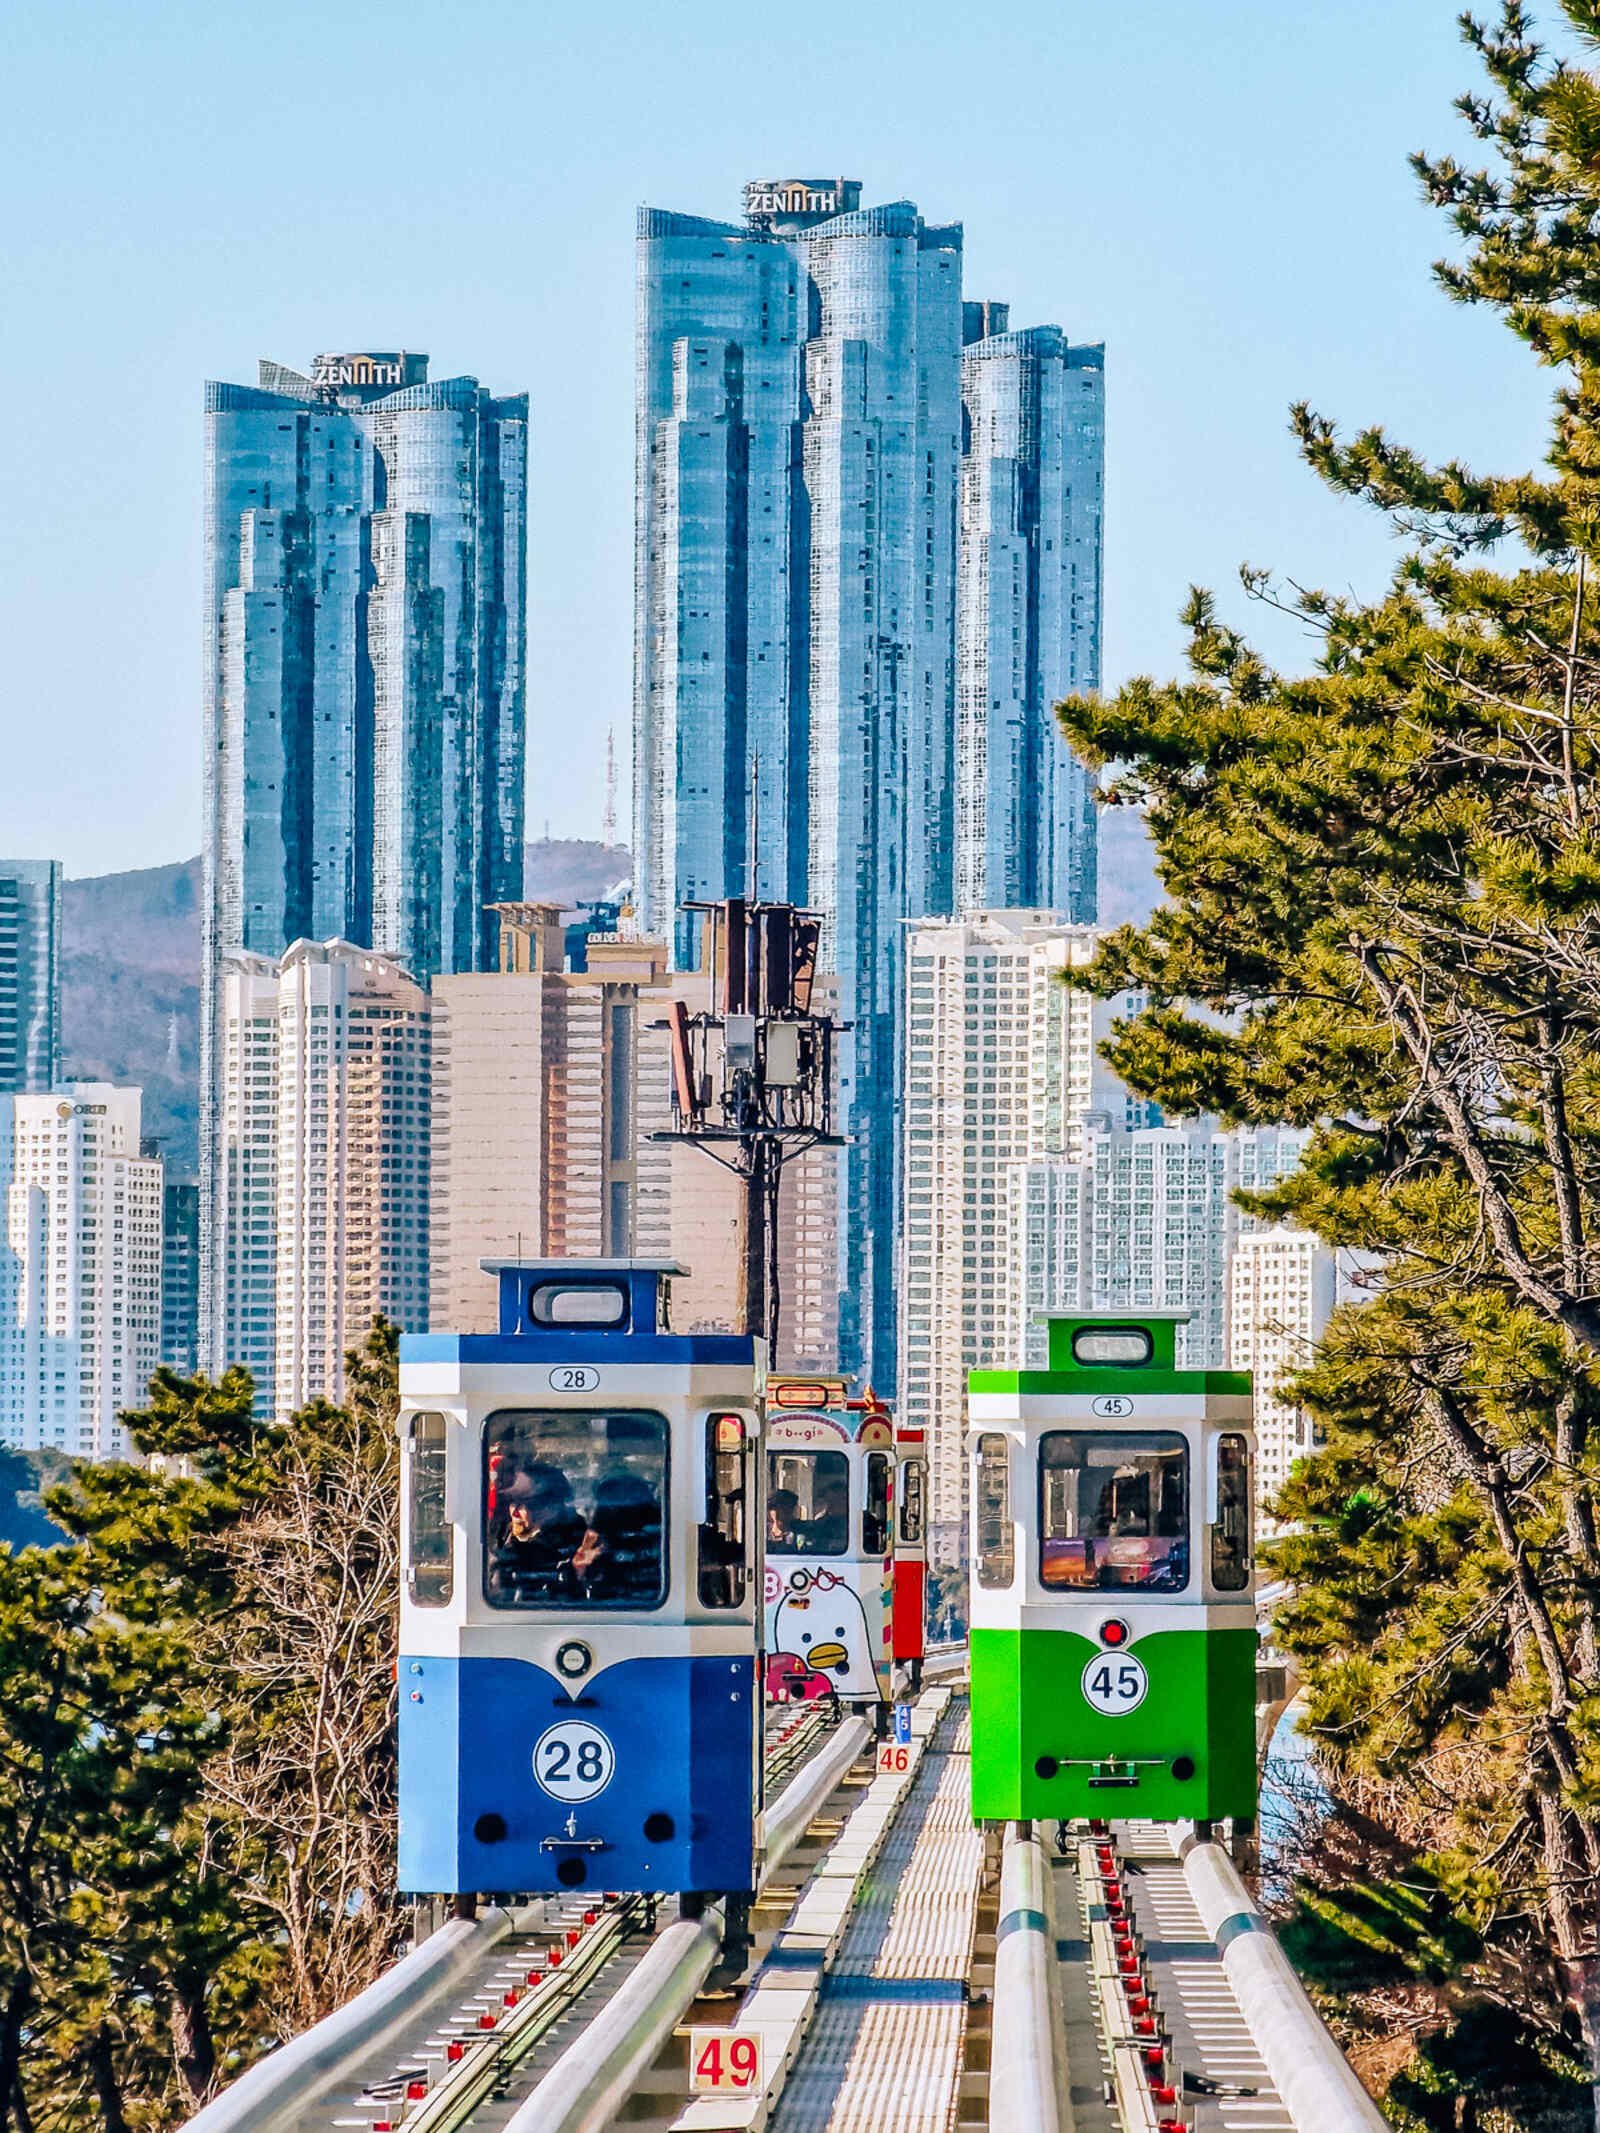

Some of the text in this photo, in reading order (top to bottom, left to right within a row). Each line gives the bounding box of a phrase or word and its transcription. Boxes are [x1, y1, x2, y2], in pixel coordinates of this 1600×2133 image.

[748, 192, 836, 213] ZENITH
[315, 364, 402, 385] ZENITH
[563, 1371, 586, 1388] 28
[1103, 1399, 1123, 1414] 45
[1090, 1666, 1140, 1700] 45
[544, 1740, 604, 1783] 28
[879, 1747, 908, 1772] 46
[696, 2037, 758, 2088] 49
